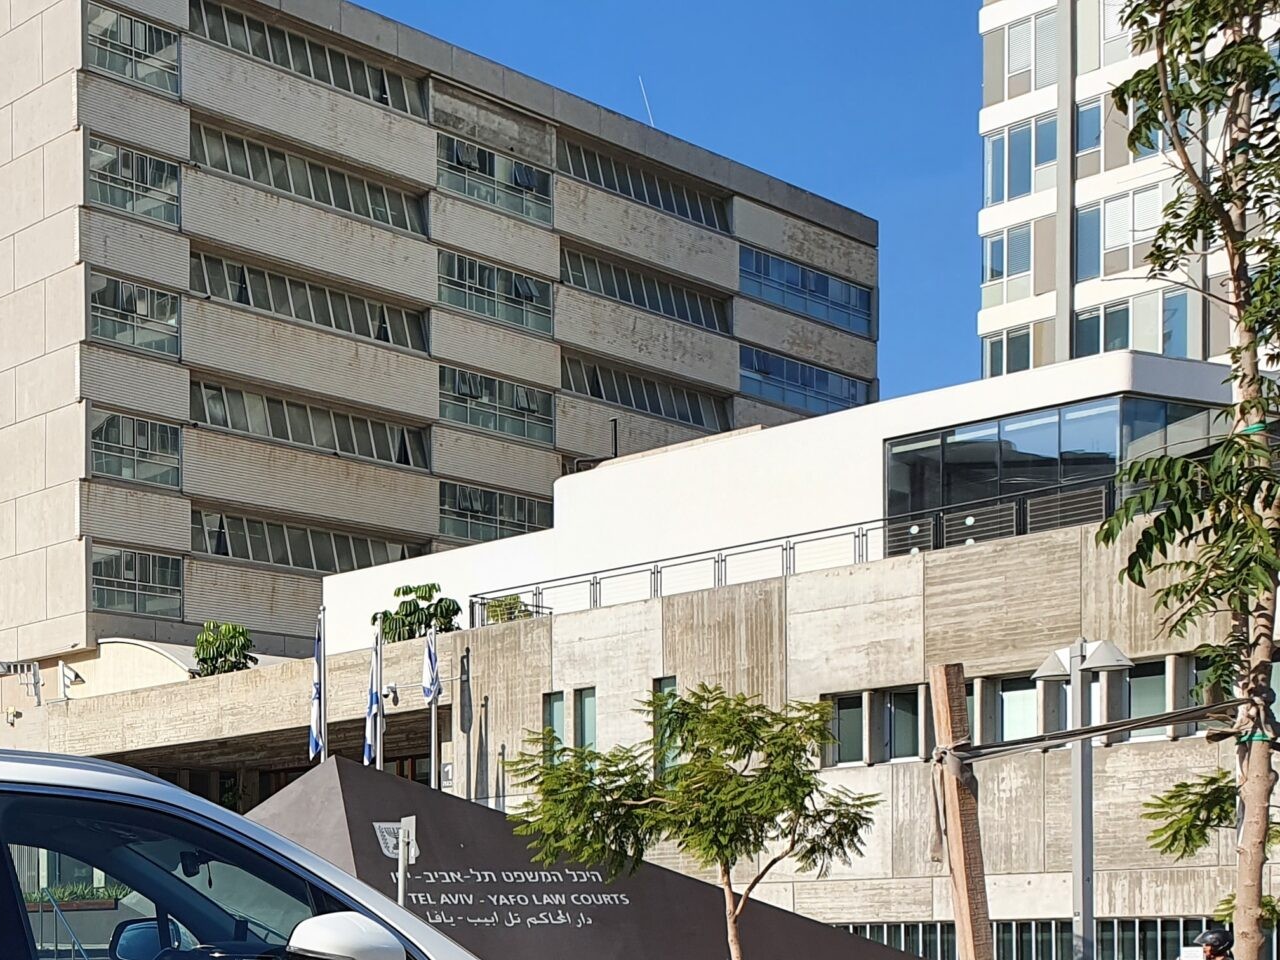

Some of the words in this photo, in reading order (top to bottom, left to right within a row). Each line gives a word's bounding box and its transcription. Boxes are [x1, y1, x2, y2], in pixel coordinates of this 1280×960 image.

[444, 765, 453, 780] 1
[501, 870, 564, 883] המשפט
[565, 868, 603, 883] היכל
[408, 893, 436, 905] TEL
[440, 893, 473, 905] AVIV
[488, 894, 529, 906] YAFO
[532, 894, 567, 906] LAW
[571, 894, 630, 906] COURTS
[504, 911, 521, 927] تل
[576, 912, 593, 927] دار
